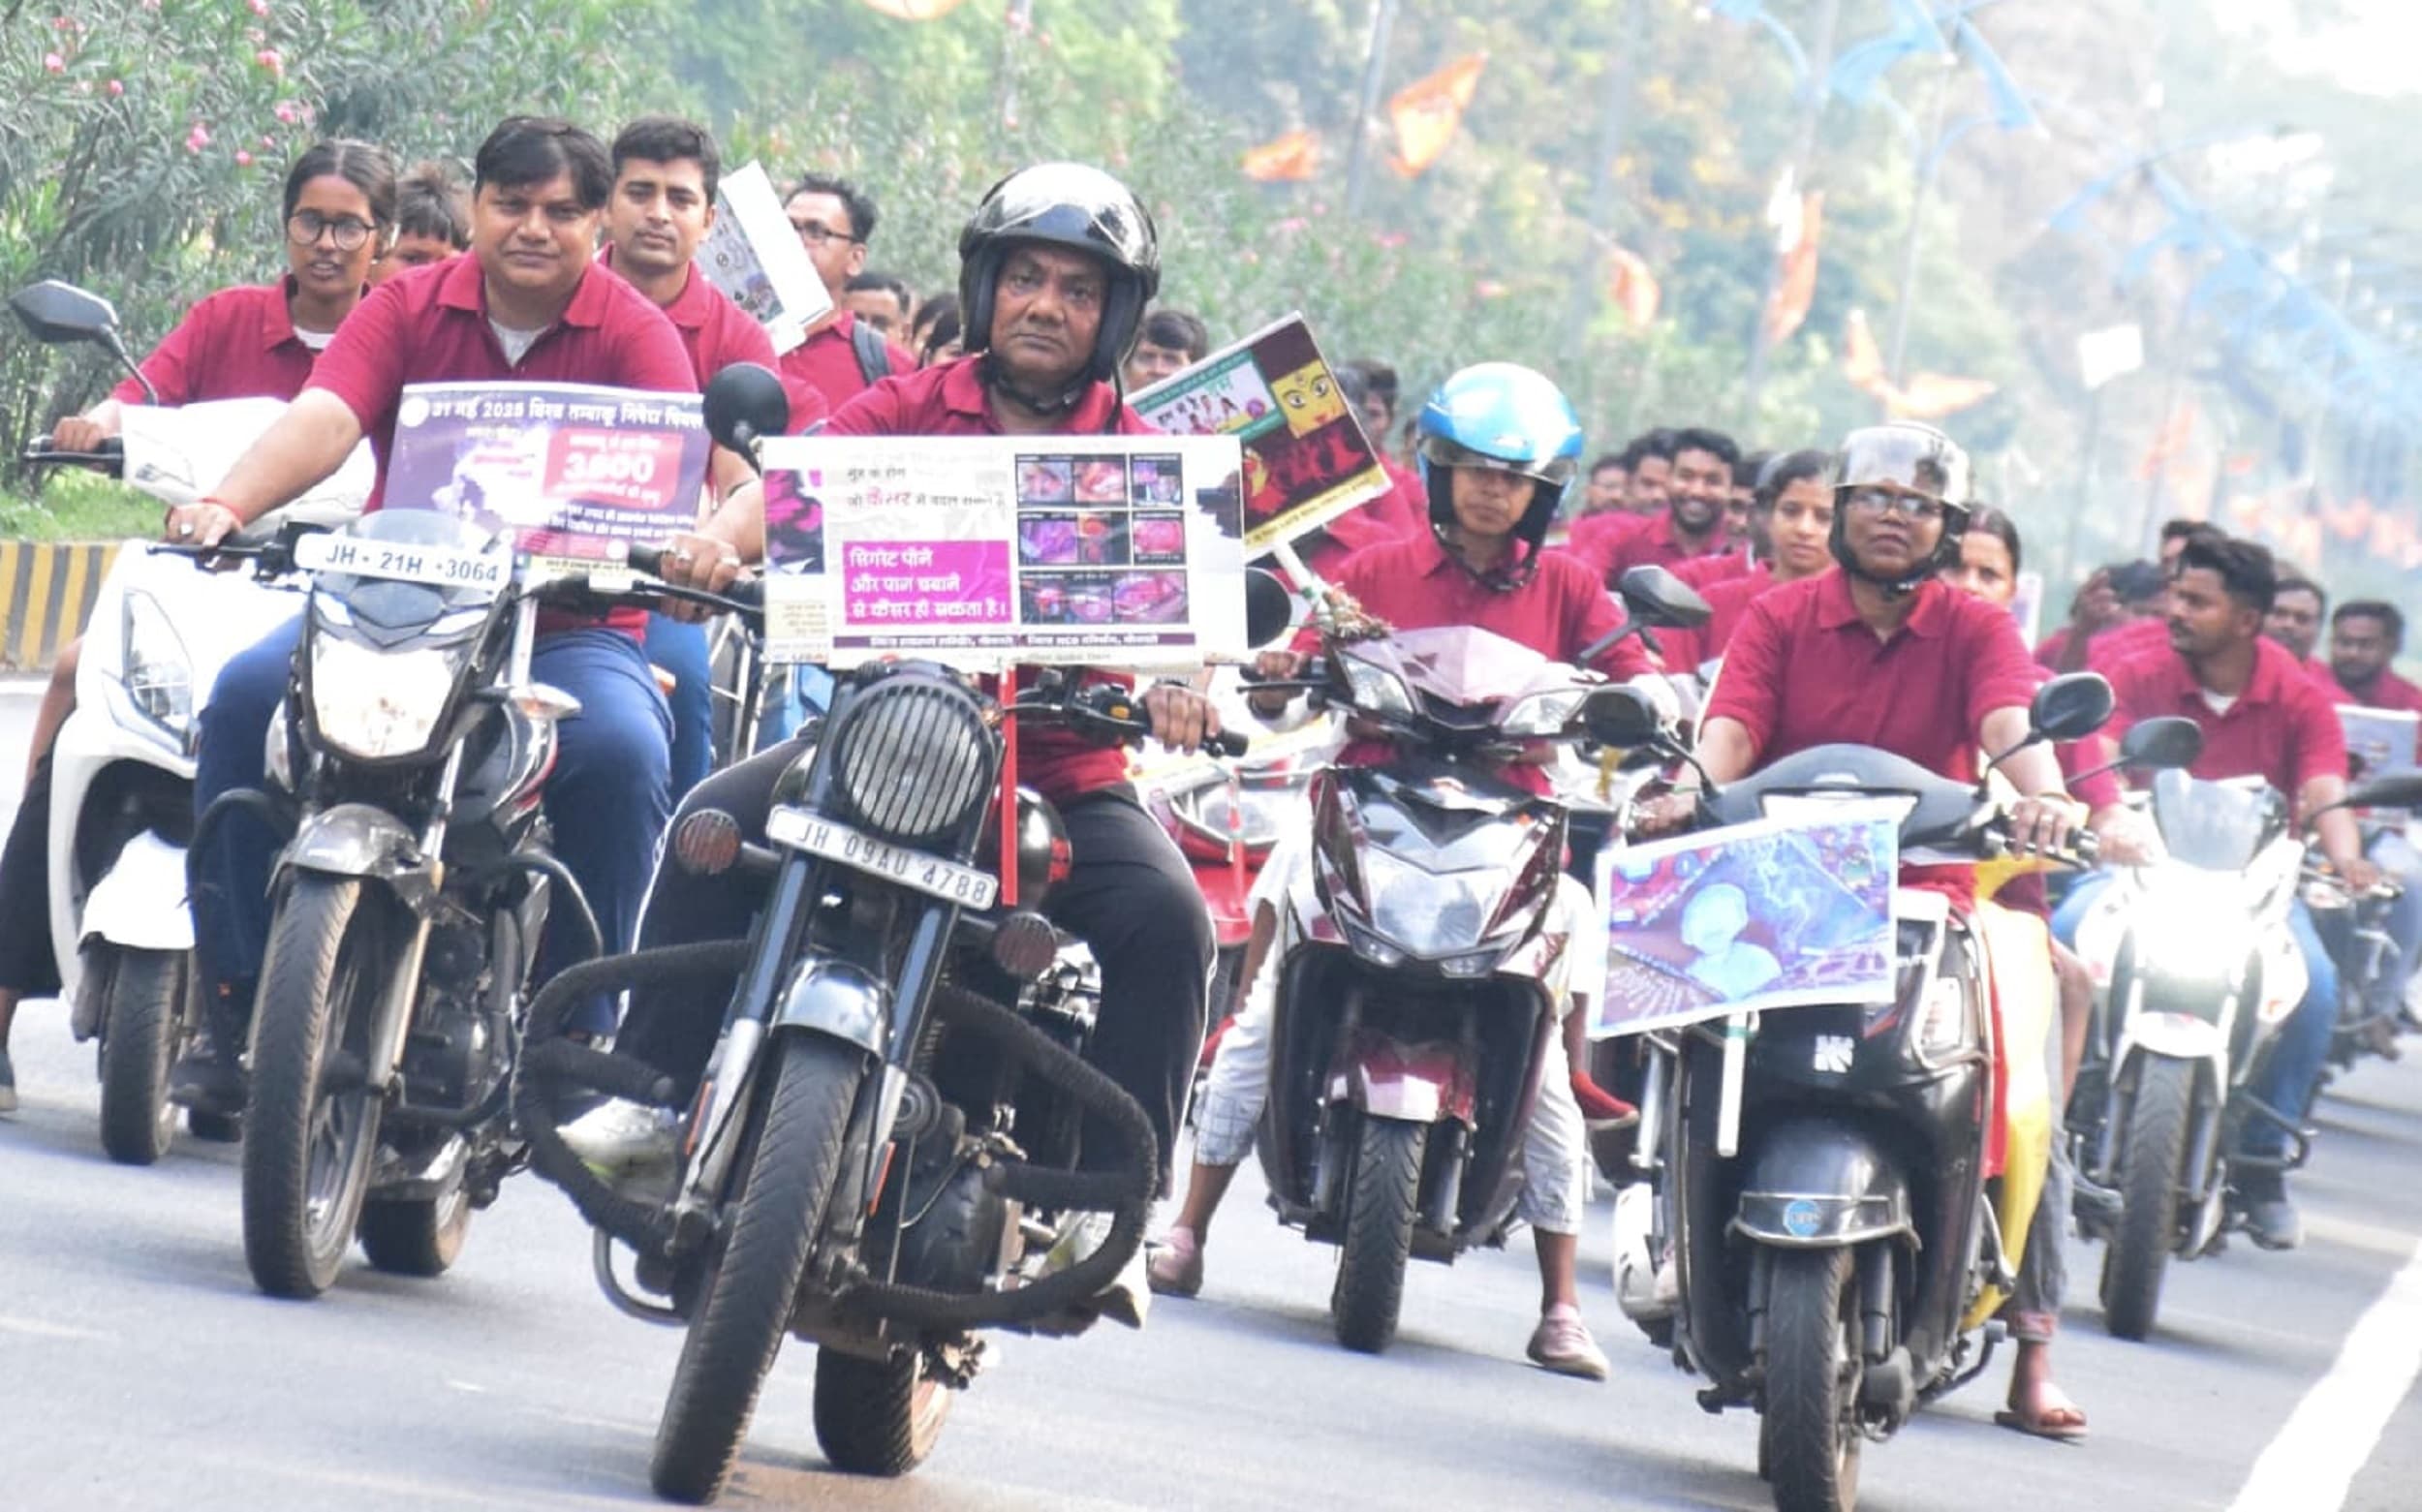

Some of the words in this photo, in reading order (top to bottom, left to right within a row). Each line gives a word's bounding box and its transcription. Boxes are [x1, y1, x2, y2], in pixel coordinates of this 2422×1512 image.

[326, 544, 357, 565] JH
[380, 551, 423, 574] 21H
[851, 572, 880, 592] और
[883, 576, 913, 592] पान
[852, 599, 866, 618] से
[797, 822, 831, 849] JH
[845, 834, 911, 876] 09AU
[922, 863, 988, 904] 4788
